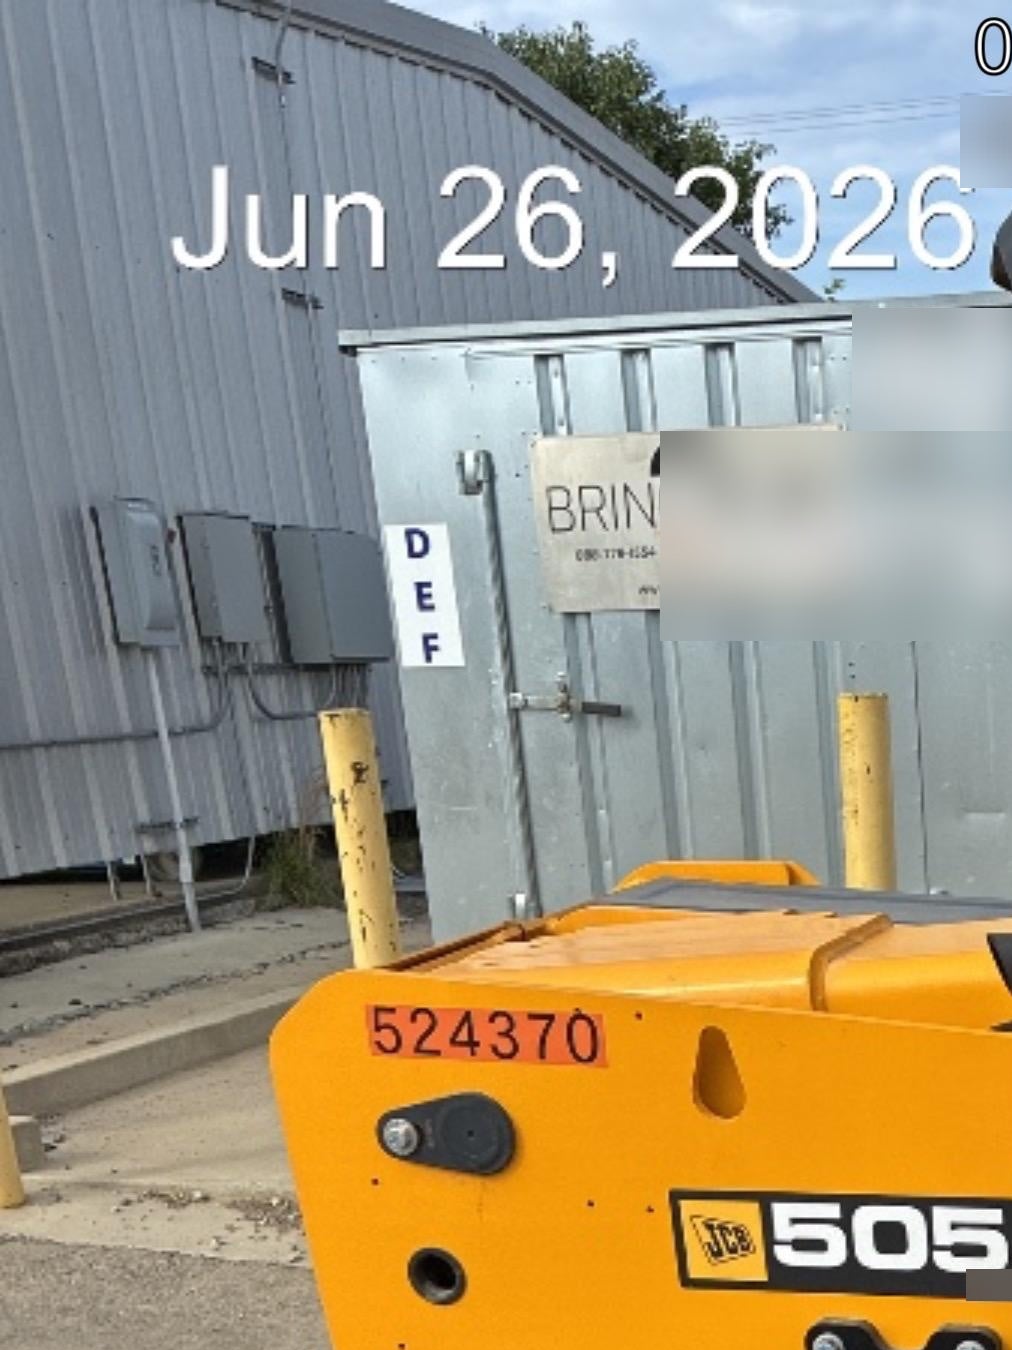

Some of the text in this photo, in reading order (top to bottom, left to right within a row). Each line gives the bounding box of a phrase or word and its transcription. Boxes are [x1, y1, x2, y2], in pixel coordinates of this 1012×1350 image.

[546, 483, 660, 533] BRIN
[373, 1006, 599, 1064] 524370
[701, 1219, 757, 1260] JCB
